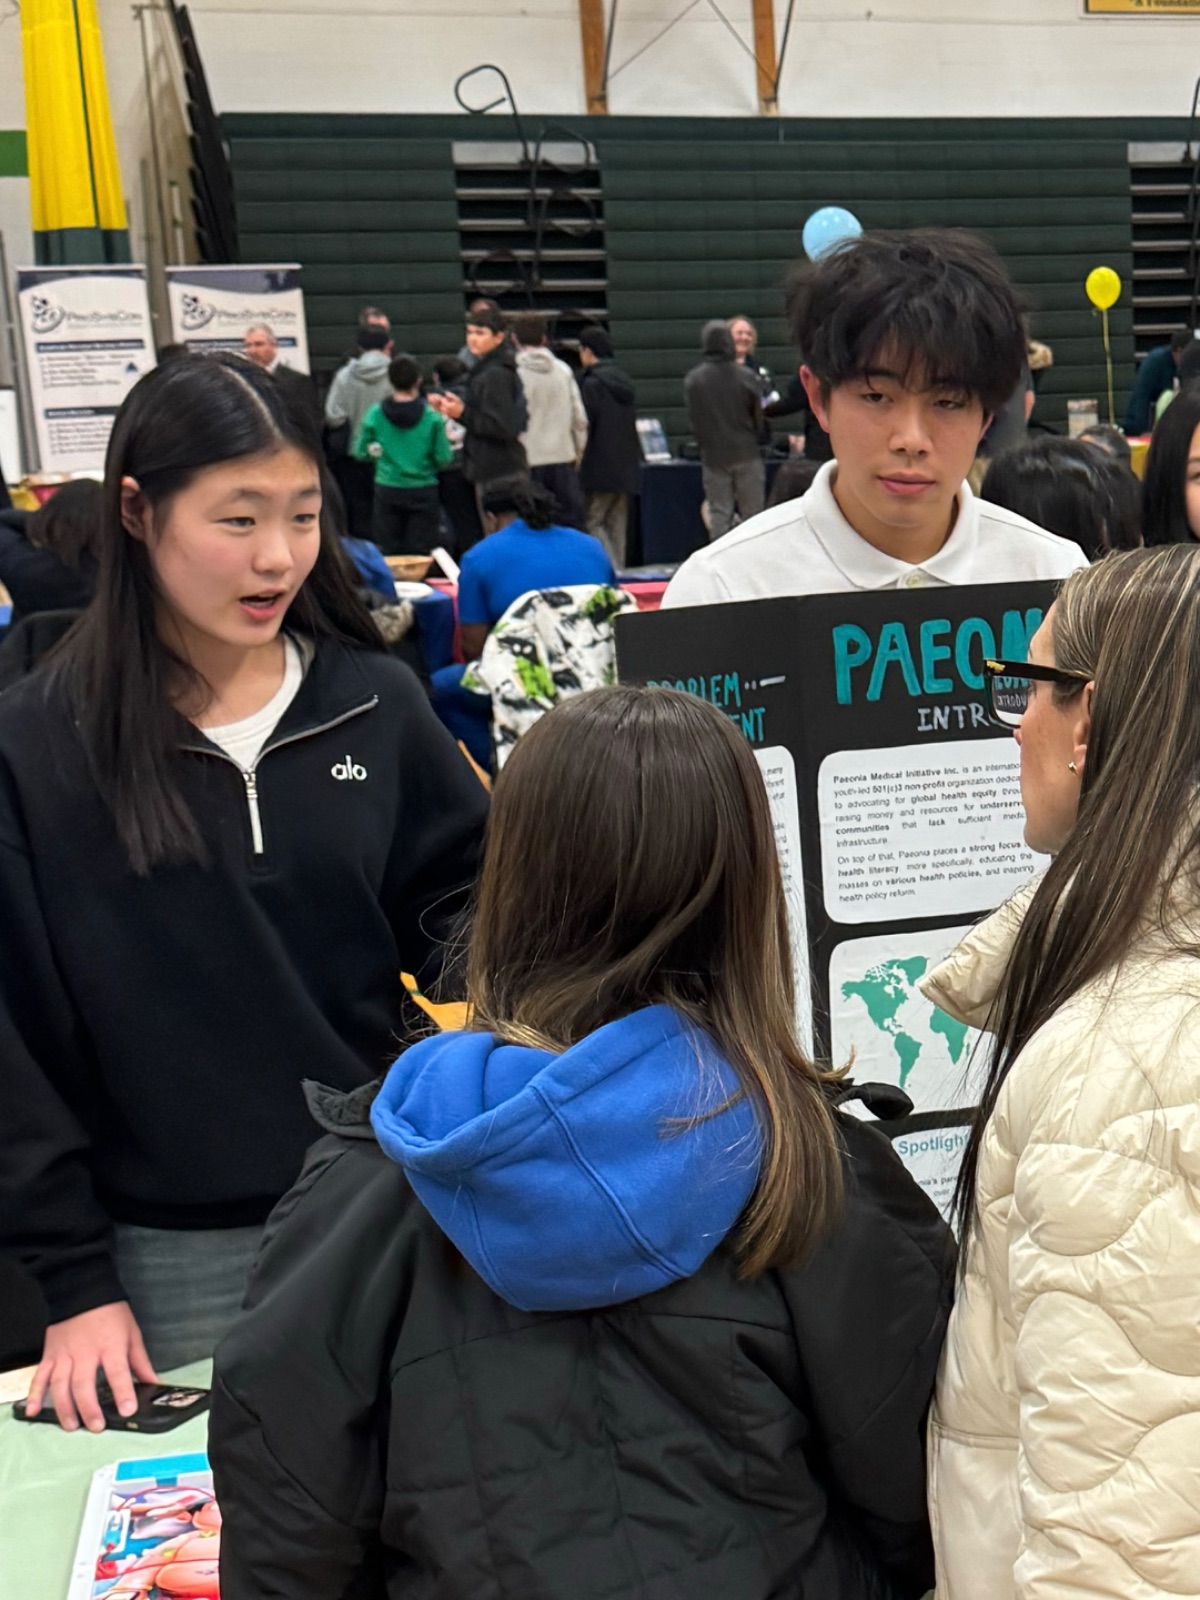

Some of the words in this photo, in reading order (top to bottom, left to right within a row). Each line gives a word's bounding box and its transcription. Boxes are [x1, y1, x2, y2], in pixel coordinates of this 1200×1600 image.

[331, 754, 367, 781] alo
[833, 775, 868, 784] Paeonia
[870, 771, 903, 781] Medical
[905, 769, 942, 778] Initiative
[944, 767, 960, 775] Inc.
[962, 766, 969, 774] is
[947, 777, 995, 789] organization
[834, 802, 844, 810] to
[847, 798, 891, 808] advocating
[895, 796, 906, 804] for
[911, 793, 937, 804] global
[941, 791, 968, 801] health
[971, 789, 998, 799] equity
[835, 814, 862, 823] raising
[867, 811, 895, 820] money
[899, 808, 916, 817] and
[920, 805, 959, 815] resources
[963, 803, 975, 811] for
[835, 824, 890, 836] communities
[901, 820, 918, 829] that
[928, 817, 946, 827] lack
[957, 814, 992, 825] sufficient
[837, 856, 850, 865] On
[852, 855, 866, 864] top
[867, 853, 876, 862] of
[898, 849, 931, 859] Paeonia
[932, 847, 958, 857] places
[960, 846, 967, 854] a
[969, 843, 996, 853] strong
[998, 841, 1021, 850] focus
[837, 868, 865, 877] health
[906, 863, 927, 871] more
[979, 854, 1017, 864] educating
[1019, 852, 1033, 861] the
[838, 881, 869, 891] masses
[872, 879, 883, 888] on
[885, 876, 917, 886] various
[919, 873, 946, 883] health
[985, 867, 1001, 877] and
[1002, 864, 1035, 875] inspiring
[838, 893, 864, 903] health
[865, 891, 888, 902] policy
